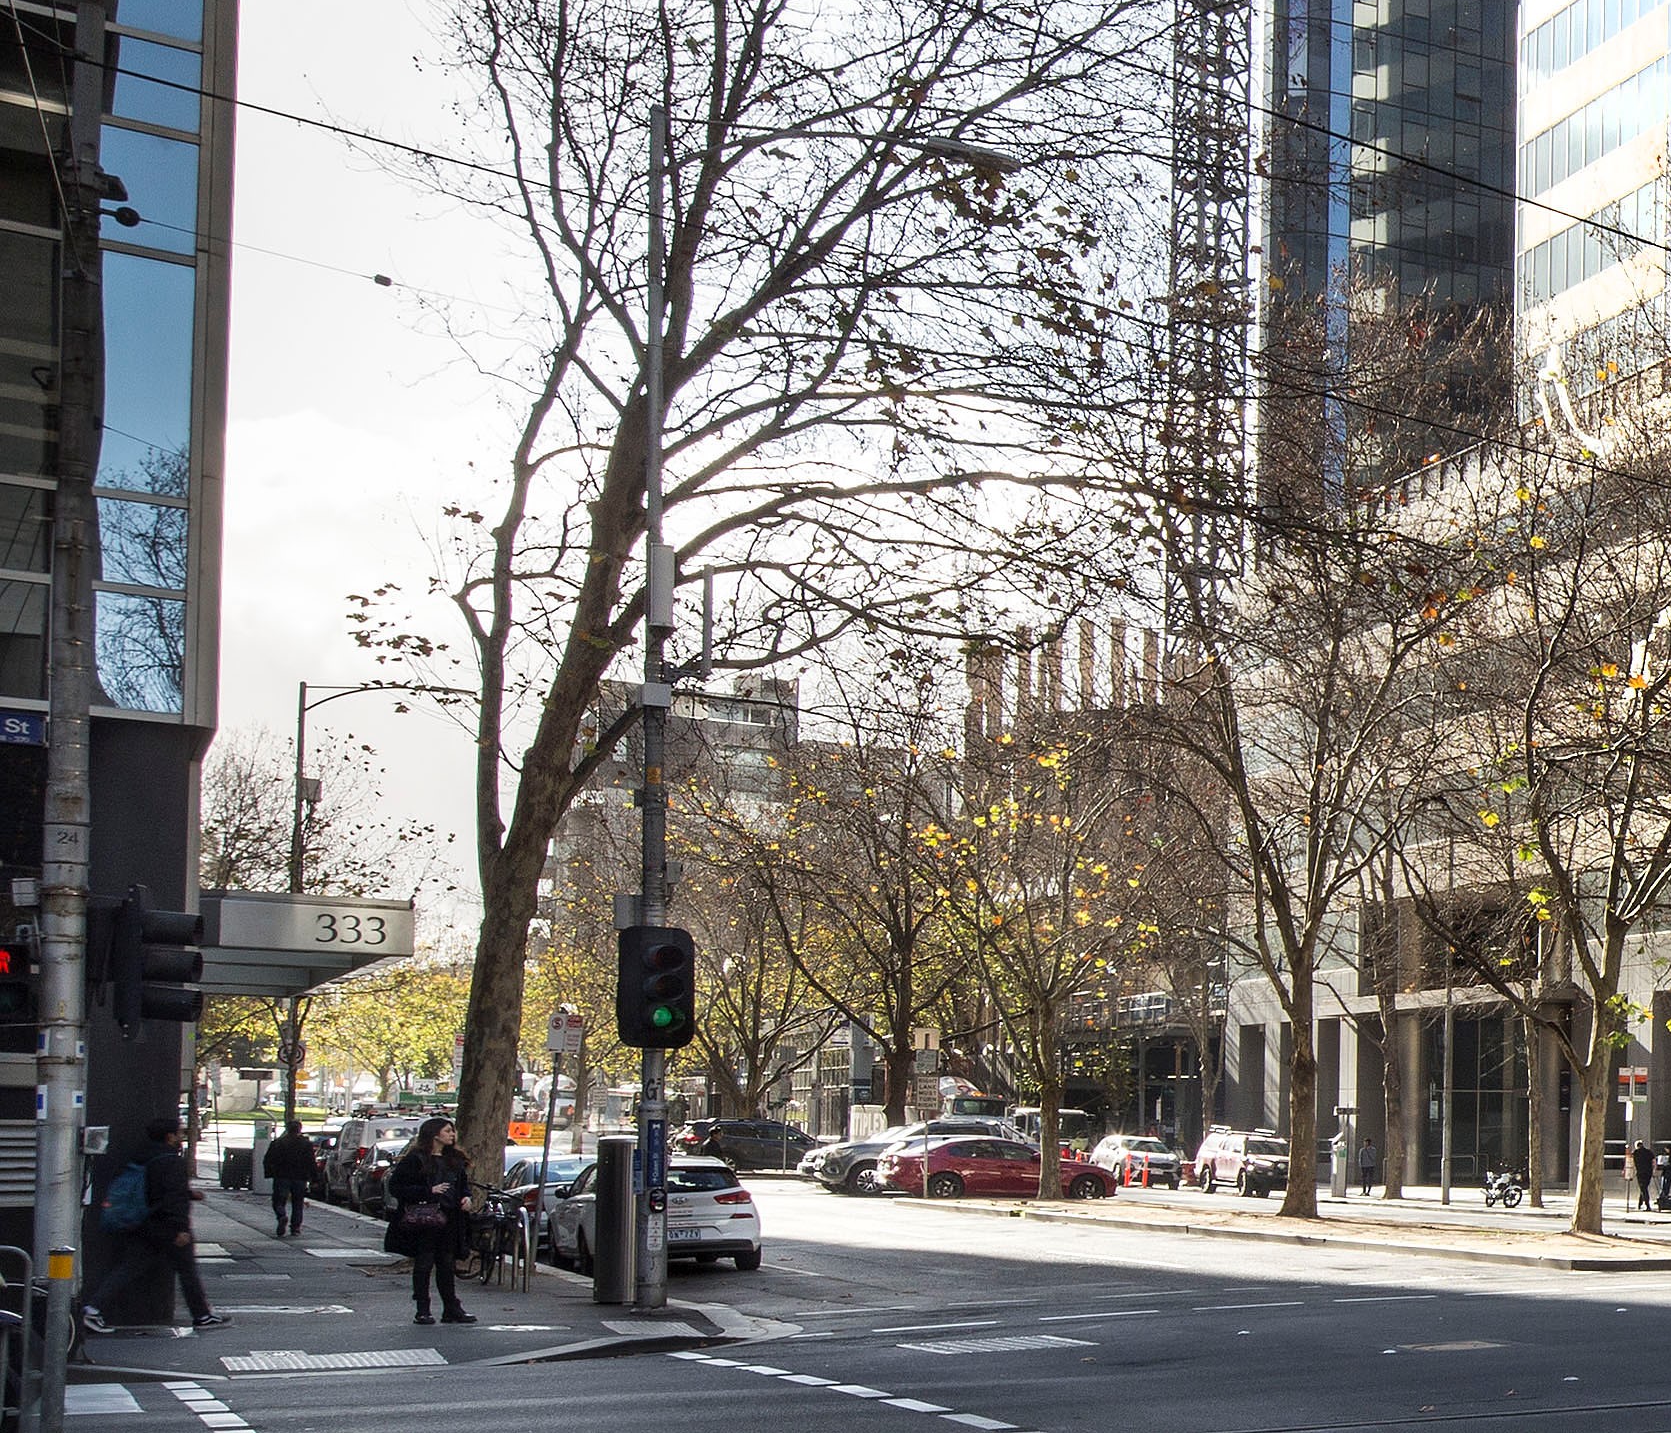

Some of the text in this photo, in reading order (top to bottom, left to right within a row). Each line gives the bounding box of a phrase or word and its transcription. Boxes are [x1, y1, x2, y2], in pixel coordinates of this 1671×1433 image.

[4, 718, 30, 734] St
[57, 831, 80, 844] 24
[315, 913, 386, 945] 333
